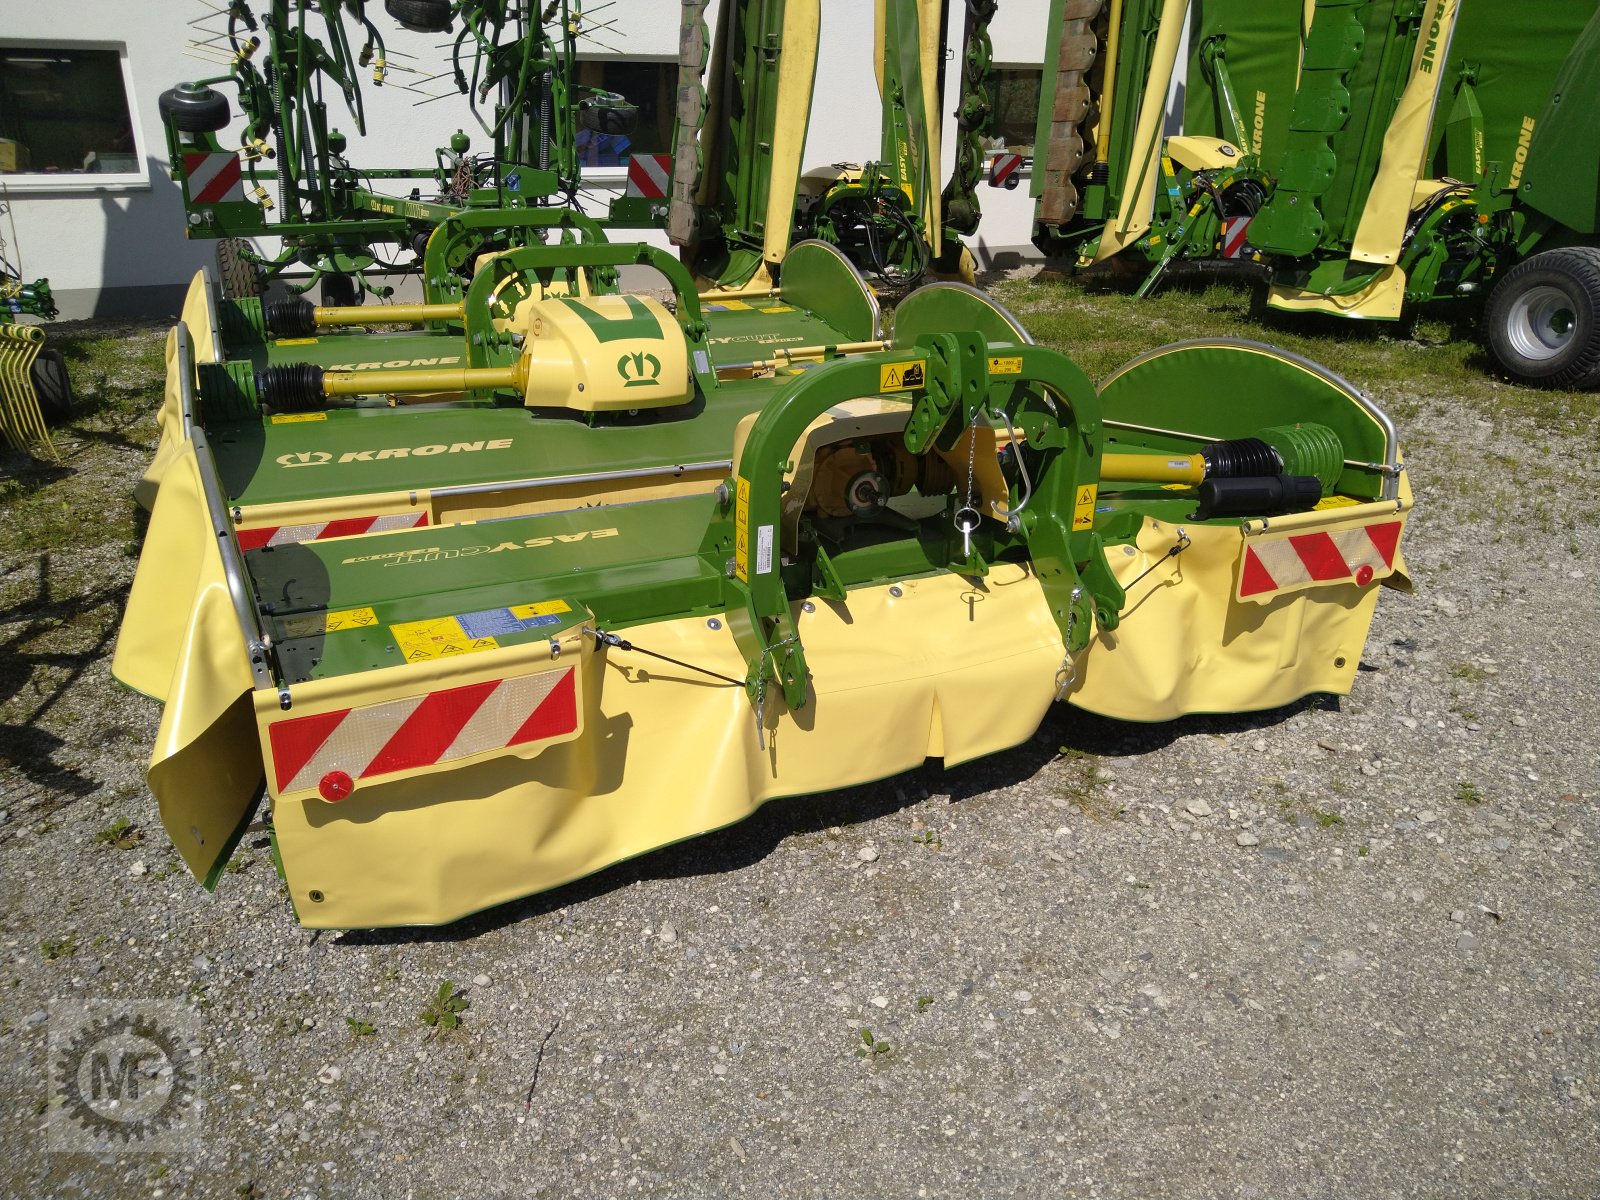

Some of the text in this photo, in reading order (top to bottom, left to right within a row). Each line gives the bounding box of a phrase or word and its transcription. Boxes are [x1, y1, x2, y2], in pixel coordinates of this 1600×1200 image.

[1420, 0, 1446, 74] RONE
[1252, 90, 1266, 155] KRONE
[1509, 116, 1535, 189] KRONE
[329, 356, 460, 371] KRONE
[338, 438, 513, 463] KRONE
